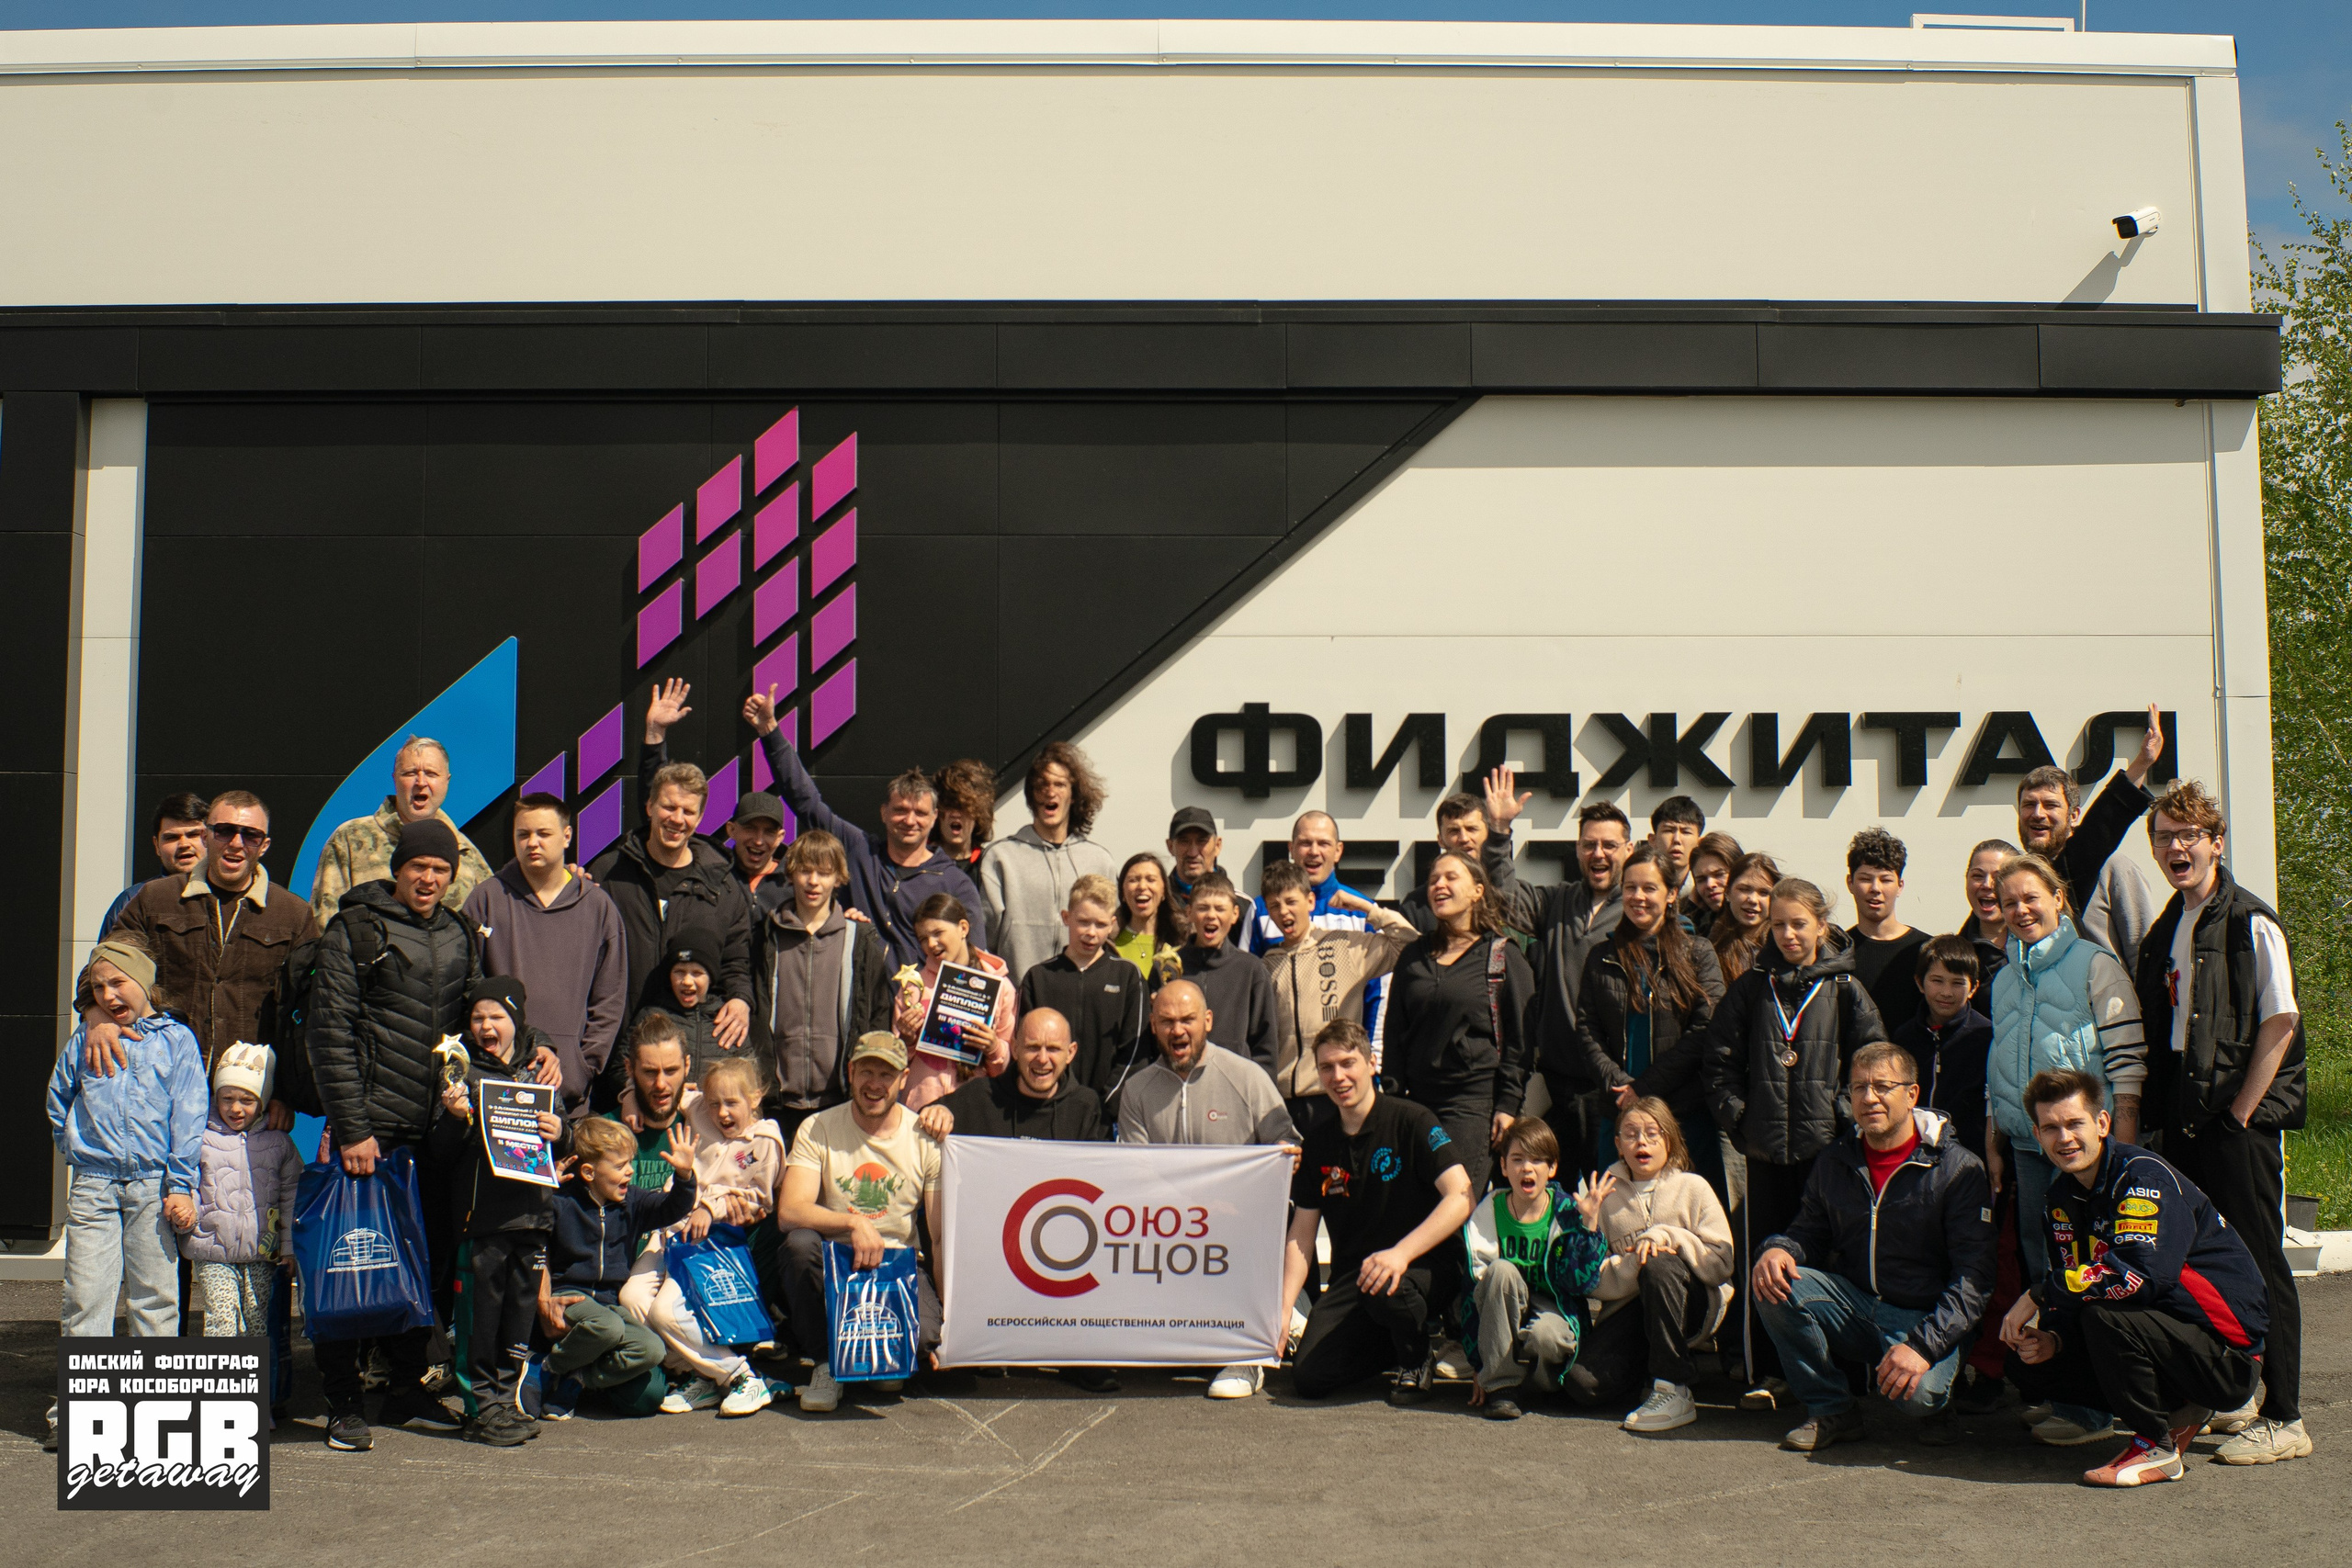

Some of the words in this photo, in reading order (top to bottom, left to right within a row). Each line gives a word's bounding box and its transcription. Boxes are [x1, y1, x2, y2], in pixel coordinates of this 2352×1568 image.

[1191, 703, 2178, 797] ФИДЖИТАЛ
[940, 993, 989, 1012] ДИПЛОМ
[505, 1140, 538, 1151] МЕСТО
[2126, 1187, 2161, 1199] ASIO
[2114, 1234, 2157, 1250] GEOX
[987, 1316, 1077, 1326] ВСЕРОССИЙСКАЯ
[1080, 1317, 1165, 1328] ОБЩЕСТВЕННАЯ
[1169, 1318, 1245, 1329] ОРГАНИЗАЦИЯ
